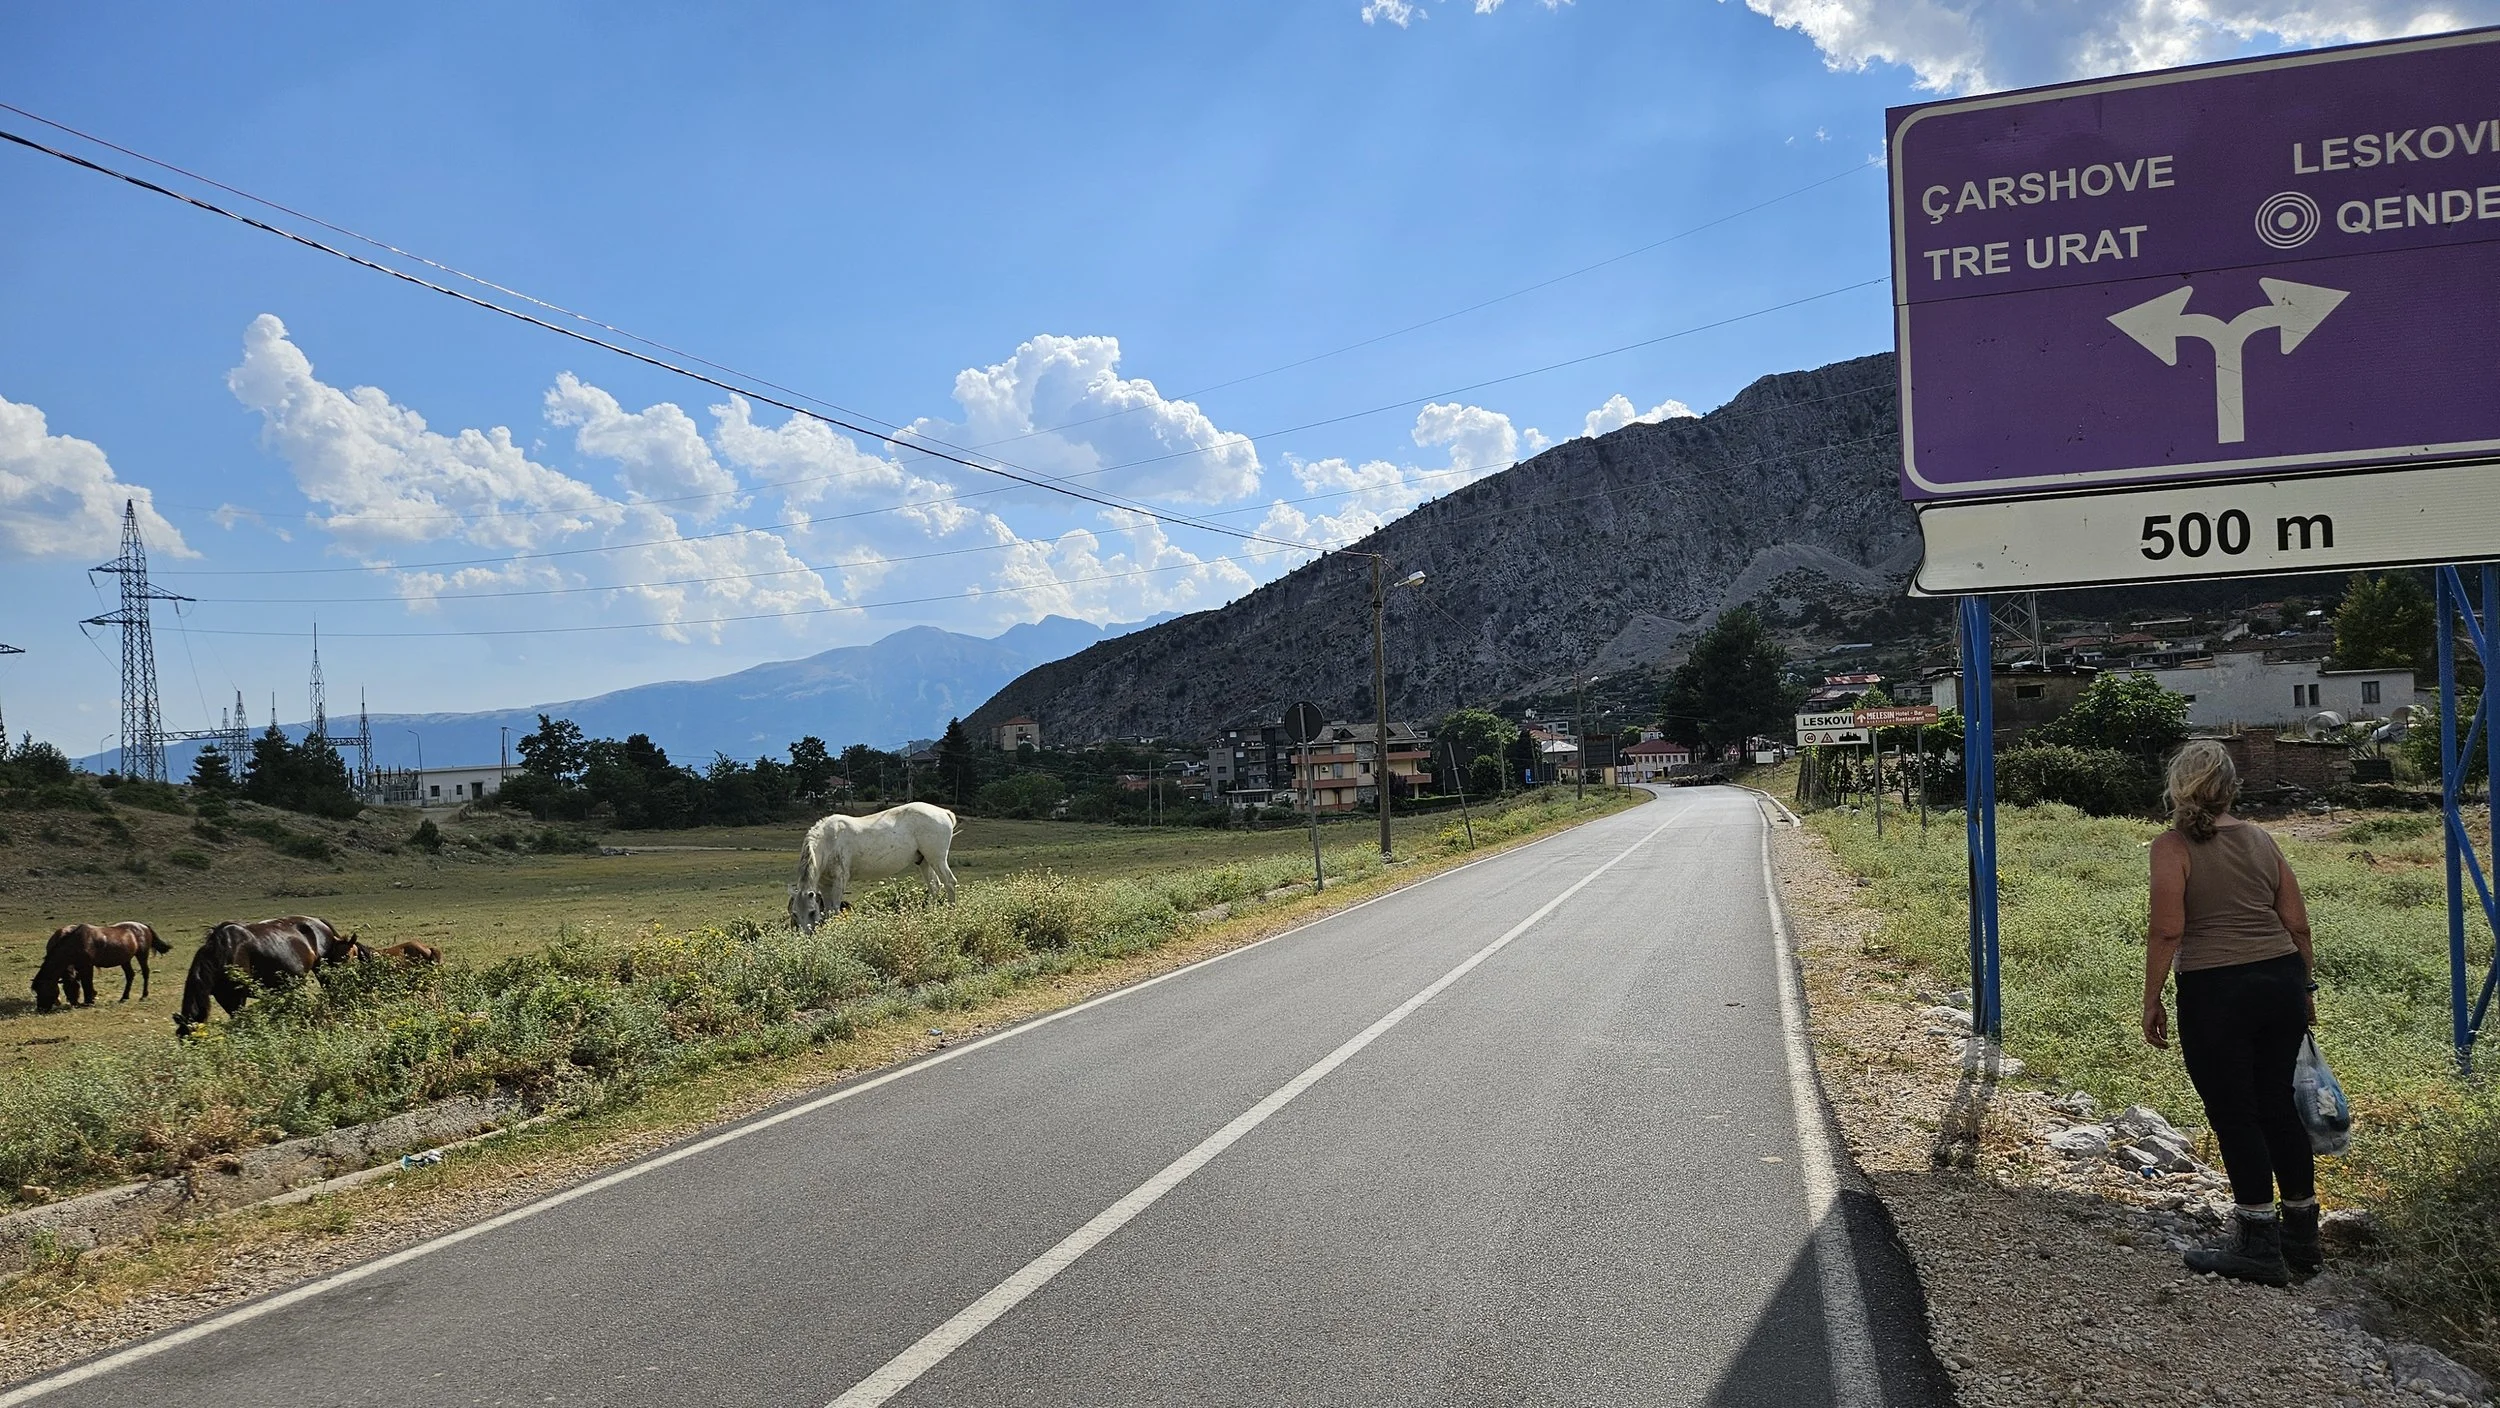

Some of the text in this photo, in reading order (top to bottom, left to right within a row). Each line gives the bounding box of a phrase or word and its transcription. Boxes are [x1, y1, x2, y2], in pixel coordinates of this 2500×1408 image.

[1922, 155, 2175, 224] ÇARSHOVE
[1923, 225, 2148, 281] TRE URAT
[2141, 509, 2334, 560] 500 m
[1803, 716, 1855, 726] LESKOVI
[1866, 711, 1895, 720] MELESIN
